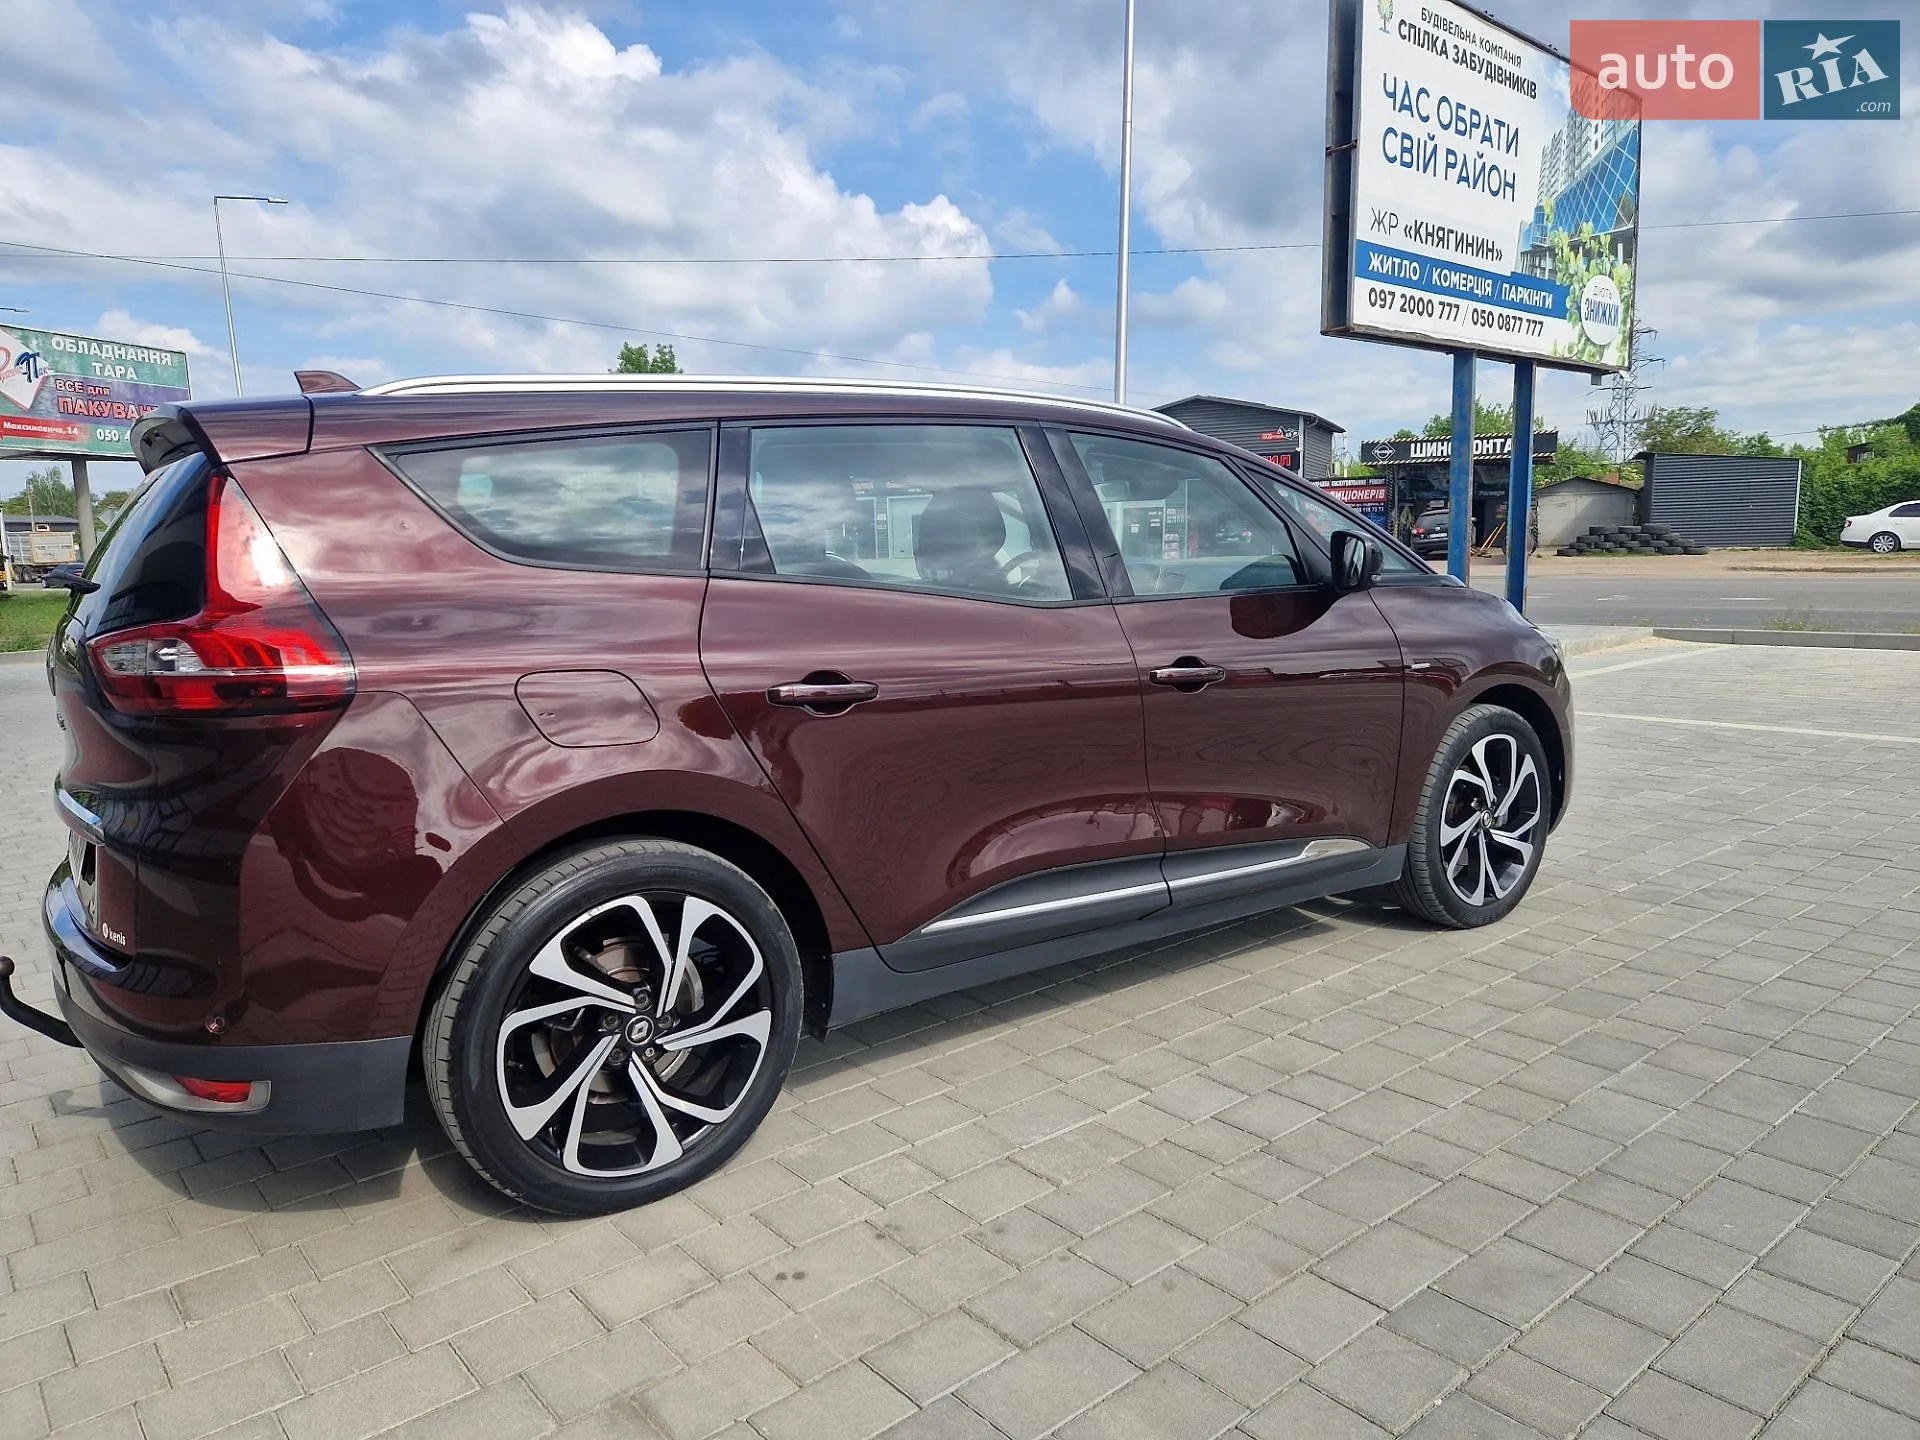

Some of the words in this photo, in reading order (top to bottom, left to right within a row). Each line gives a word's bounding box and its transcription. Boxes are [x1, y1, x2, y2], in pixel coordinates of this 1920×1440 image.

[1398, 19, 1448, 60] СПІЛКА
[1452, 44, 1537, 100] ЗАБУДІВНИКІВ
[1421, 8, 1477, 47] БУДІВЕЛЬНА
[1479, 38, 1522, 69] КОМПАНІЯ
[1383, 72, 1430, 124] ЧАС
[1437, 95, 1519, 158] ОБРАТИ
[1382, 127, 1438, 178] СВІЙ
[1445, 147, 1516, 203] РАЙОН
[1370, 207, 1399, 236] ЖР
[1403, 219, 1503, 262] «КНЯГИНИН»
[1368, 251, 1420, 281] ЖИТЛО
[1432, 267, 1492, 297] КОМЕРЦІЯ
[1502, 282, 1553, 309] ПАРКІНГИ
[1368, 287, 1396, 310] 097
[1399, 293, 1434, 318] 2000
[1438, 300, 1460, 323] 777
[1471, 307, 1494, 329] 050
[1497, 313, 1524, 334] 0877
[1525, 319, 1544, 338] 777
[1584, 297, 1619, 327] ЗНИЖКИ
[51, 336, 172, 366] ОБЛАДНАННЯ
[92, 361, 138, 381] ТАРА
[56, 379, 84, 394] ВСЕ
[96, 428, 119, 442] 050
